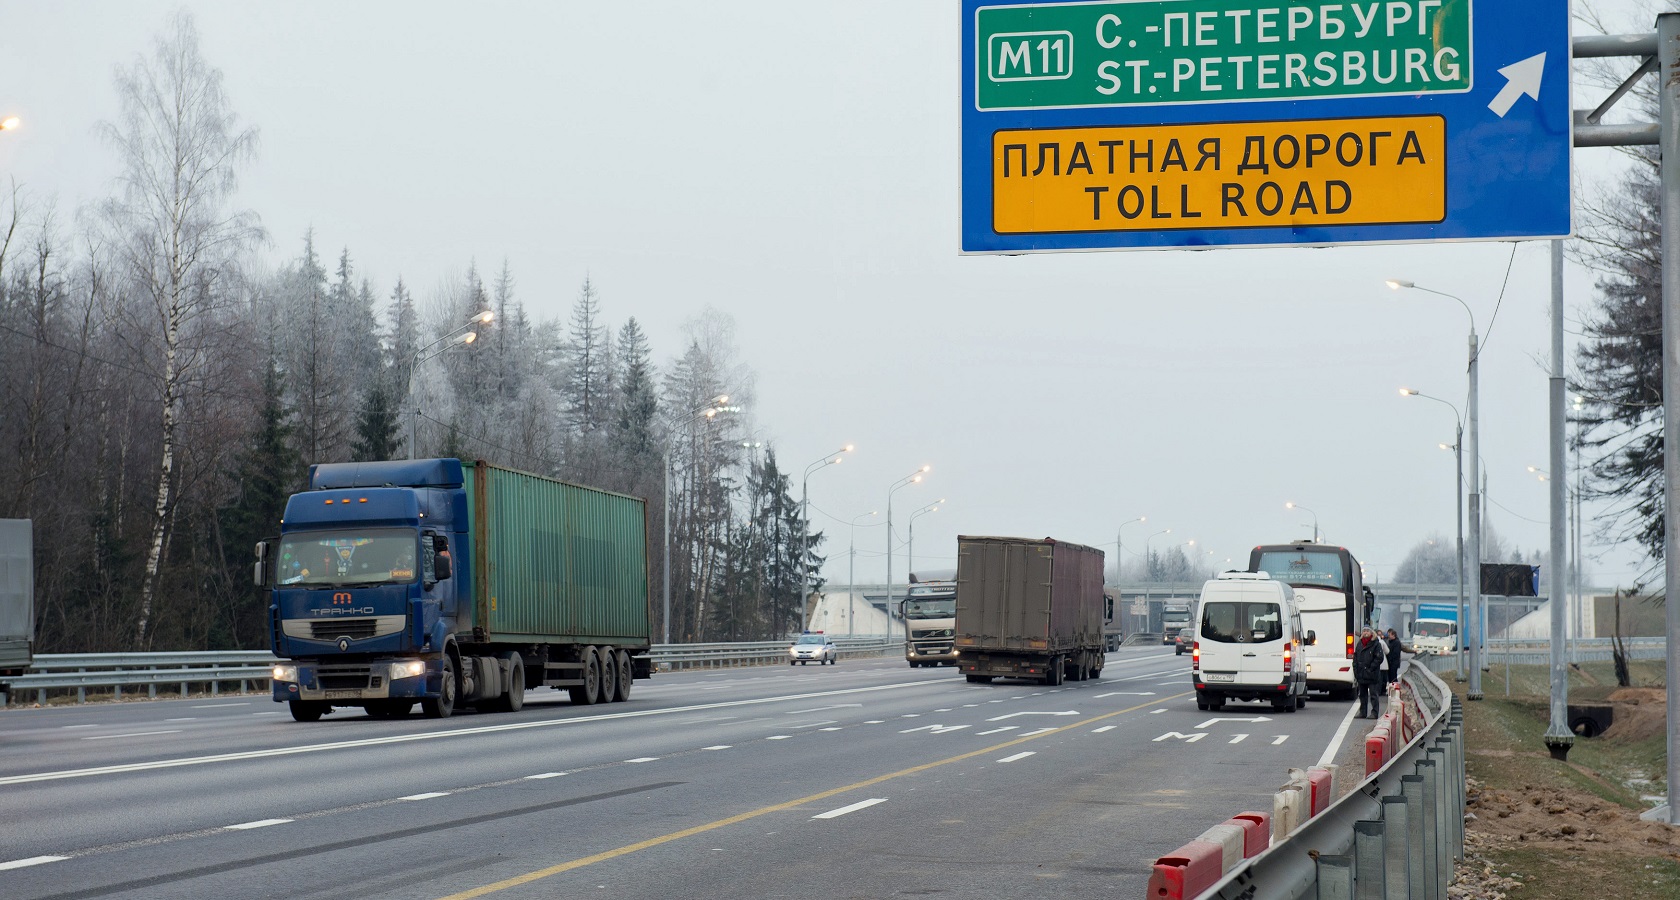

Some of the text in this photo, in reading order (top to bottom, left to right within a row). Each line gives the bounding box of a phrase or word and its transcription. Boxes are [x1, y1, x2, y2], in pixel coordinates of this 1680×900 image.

[998, 39, 1064, 75] M11
[1095, 47, 1460, 95] ST.-PETERSBURG
[1003, 130, 1426, 178] ПЛАТНАЯ ДОРОГА
[1084, 180, 1352, 220] TOLL ROAD
